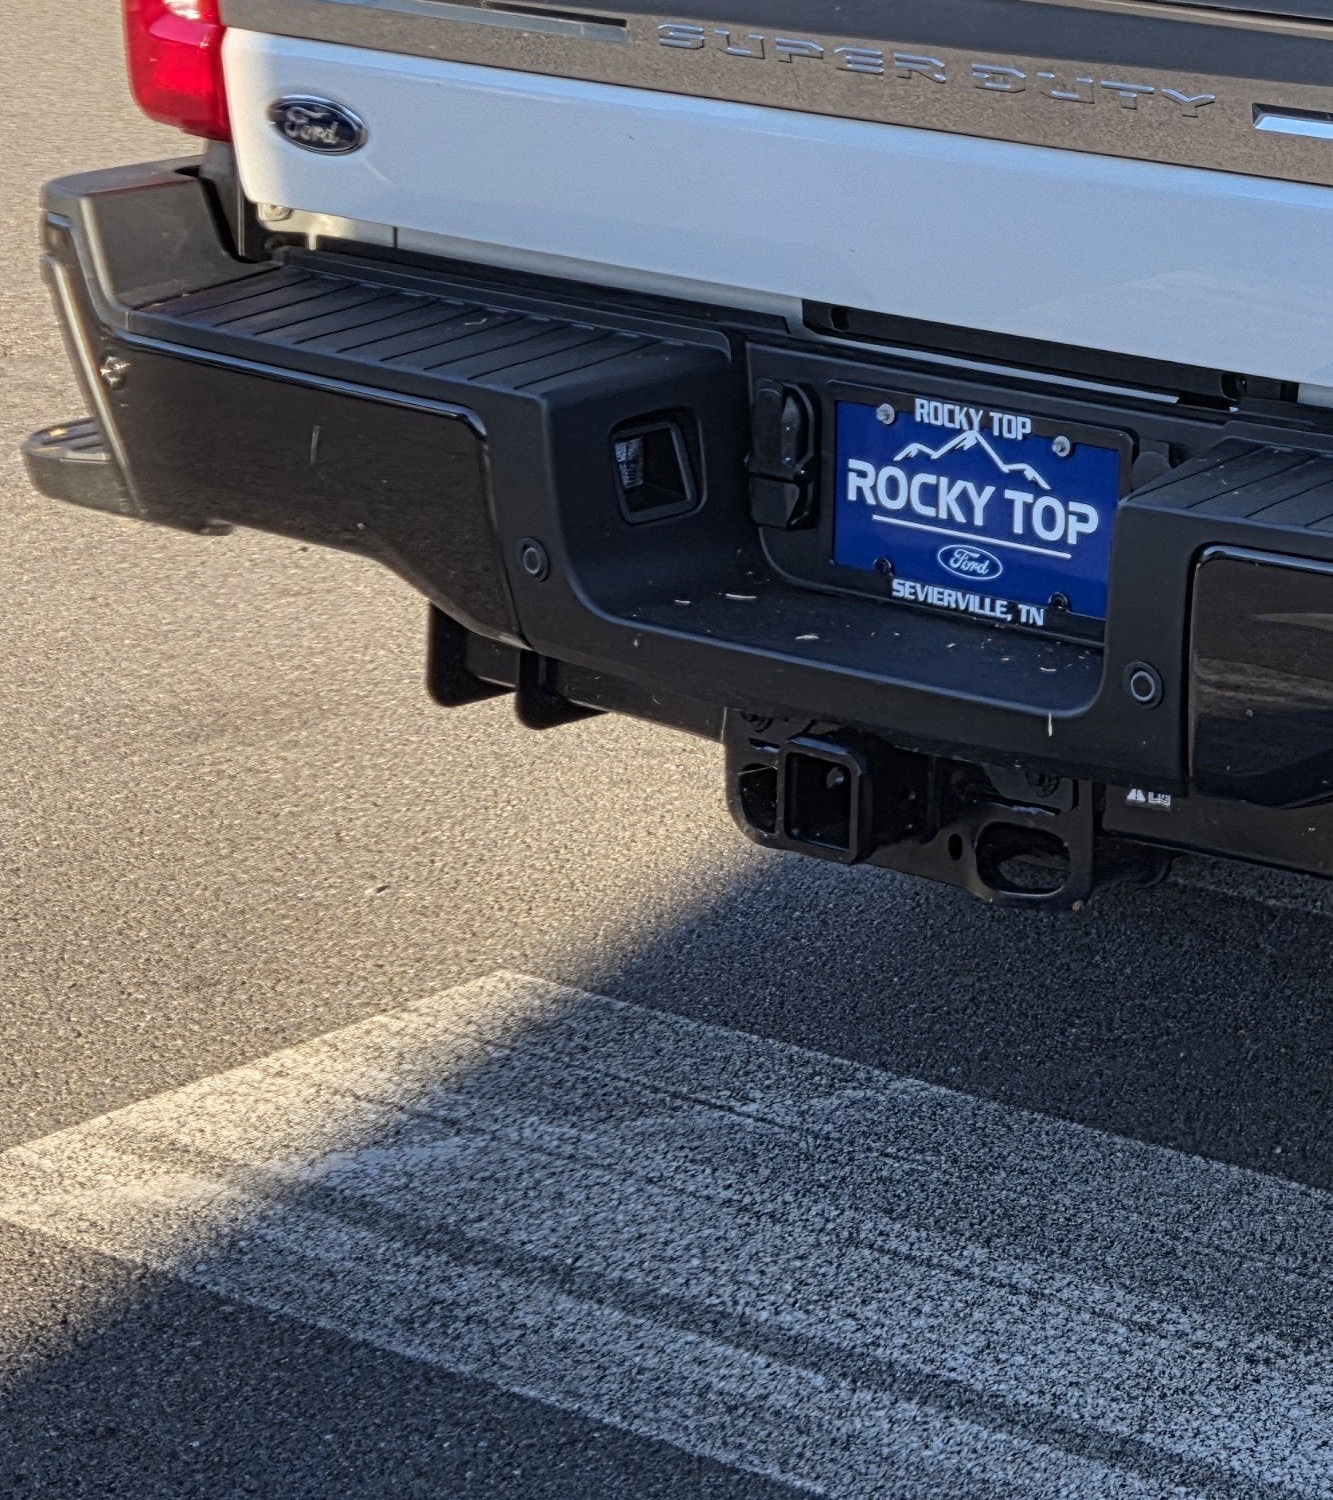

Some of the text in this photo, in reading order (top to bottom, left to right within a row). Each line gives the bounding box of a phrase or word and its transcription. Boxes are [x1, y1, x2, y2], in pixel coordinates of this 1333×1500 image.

[656, 21, 1217, 118] SUPER DUTY
[914, 397, 1032, 441] ROCKY TOP
[846, 458, 1100, 546] ROCKY TOP
[891, 578, 1045, 626] SEVIERVILLE, TN
